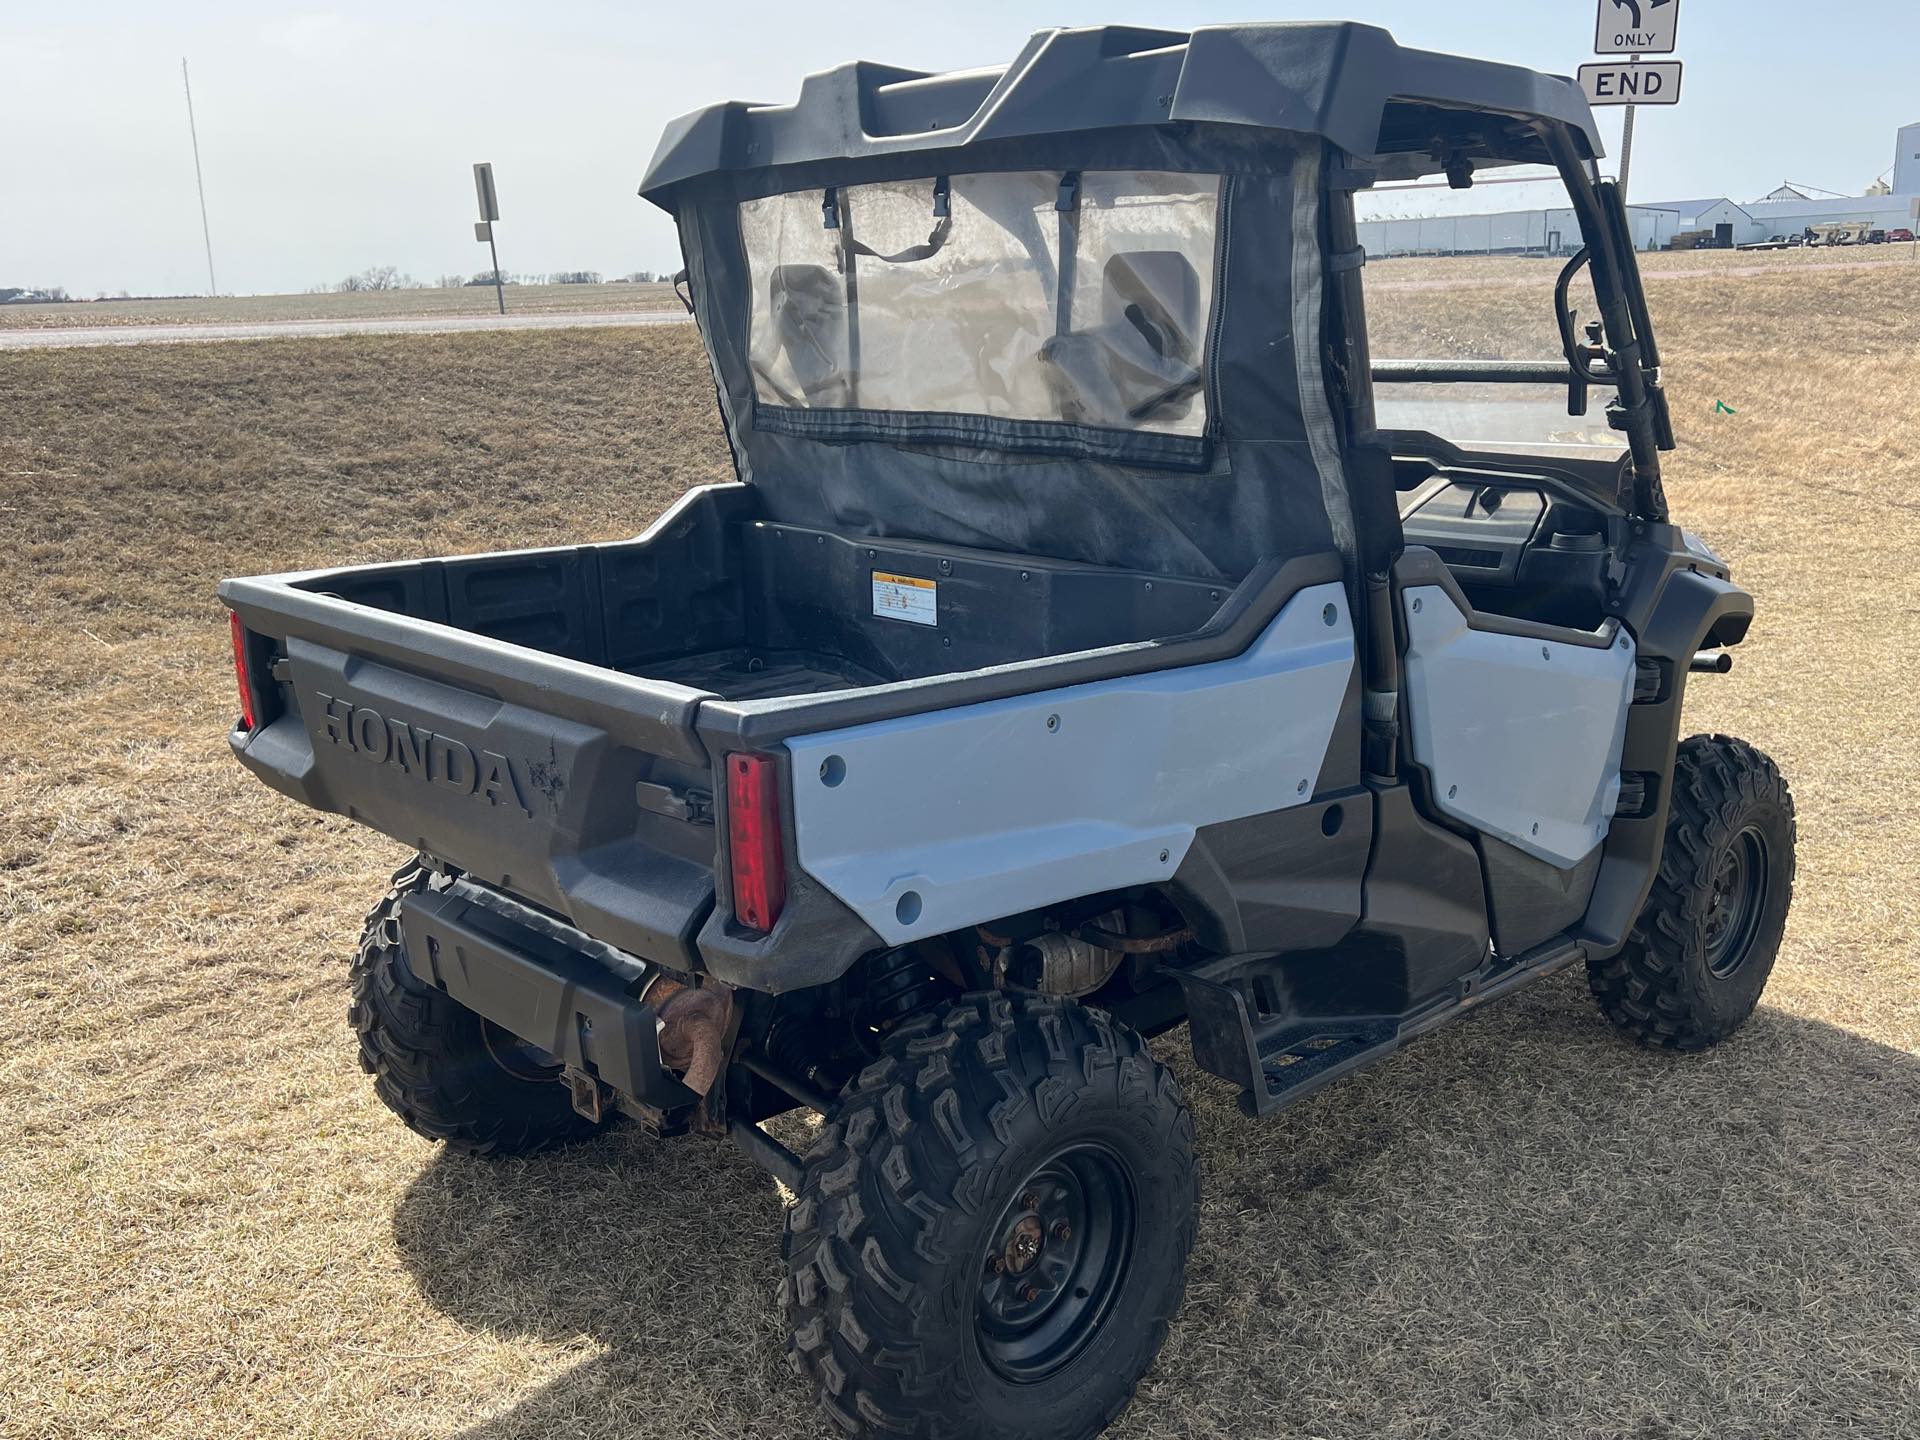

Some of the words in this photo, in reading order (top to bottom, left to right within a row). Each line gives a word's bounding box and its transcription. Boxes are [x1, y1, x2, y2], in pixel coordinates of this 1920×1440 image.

[1614, 33, 1656, 46] ONLY
[1596, 72, 1662, 96] END
[315, 691, 533, 818] HONDA
